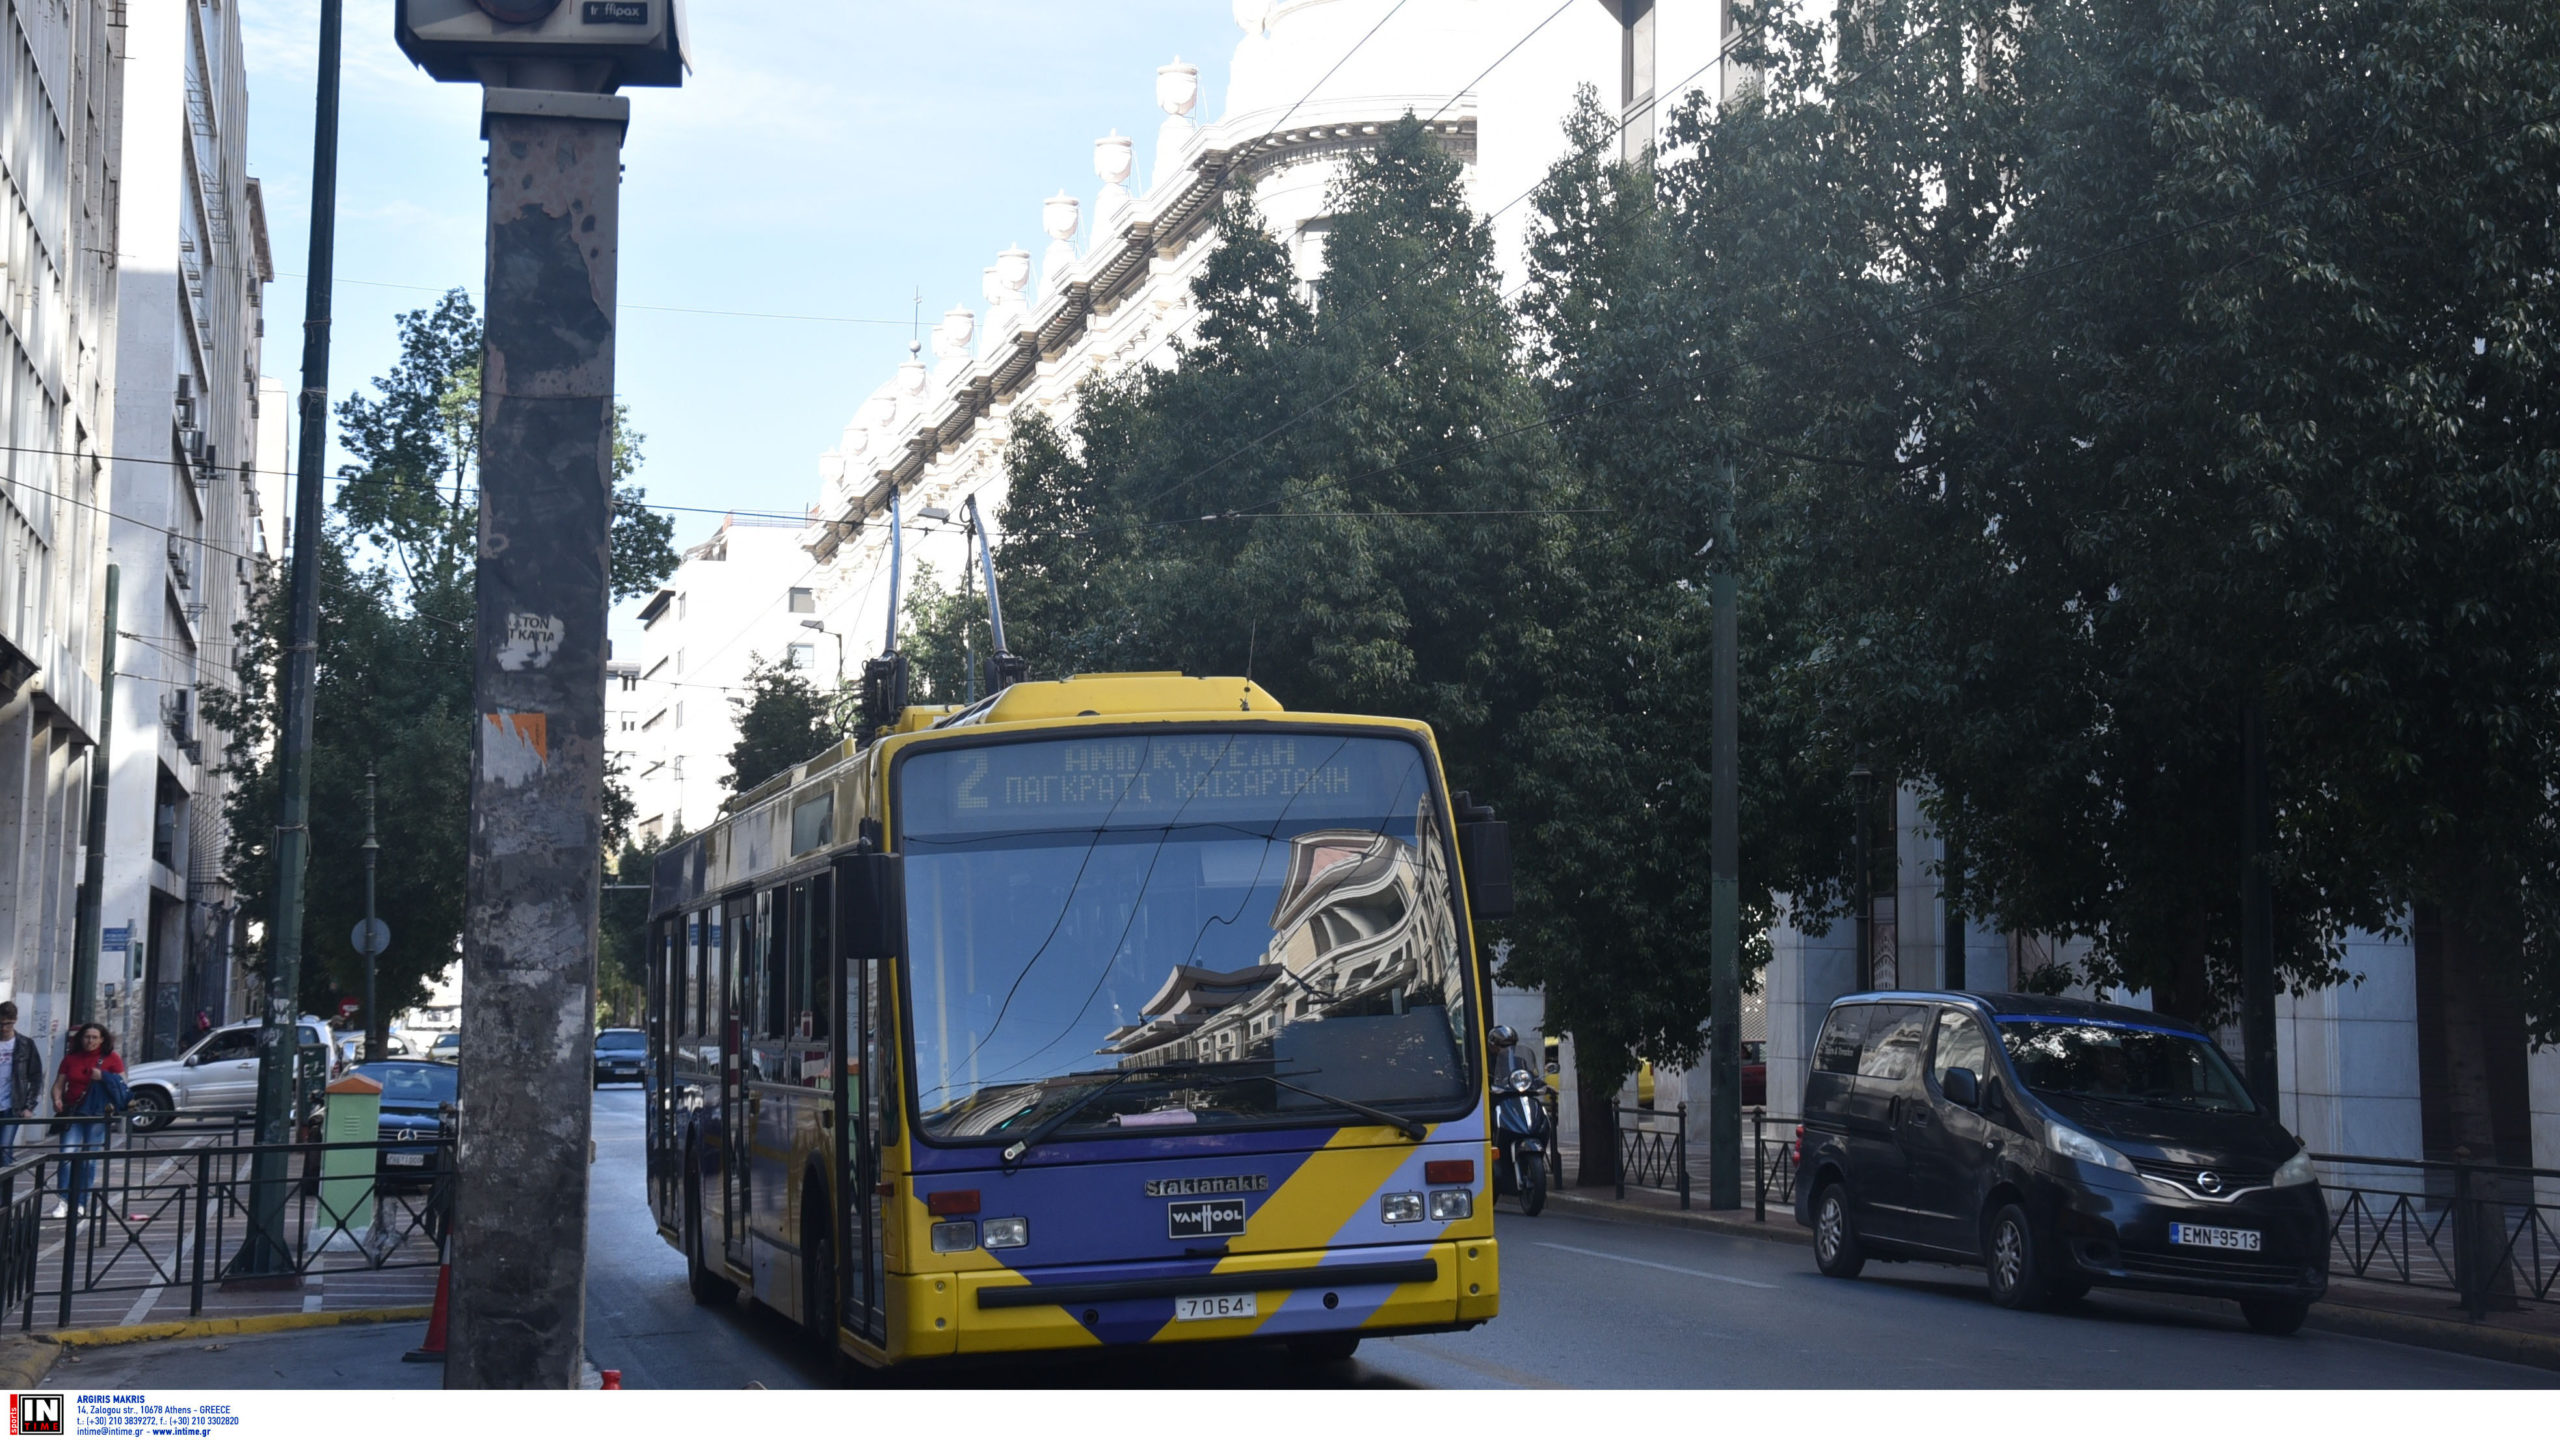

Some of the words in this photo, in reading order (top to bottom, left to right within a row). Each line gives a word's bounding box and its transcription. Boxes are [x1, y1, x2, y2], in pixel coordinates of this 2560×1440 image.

[590, 3, 640, 17] trffipax
[957, 752, 989, 808] 2
[1005, 772, 1151, 803] ΠΑΓΚΡΑΤΙ
[1175, 766, 1349, 799] ΚΑΙΣΑΡΙΑΝΗ
[1145, 1174, 1268, 1197] Sfakianakis
